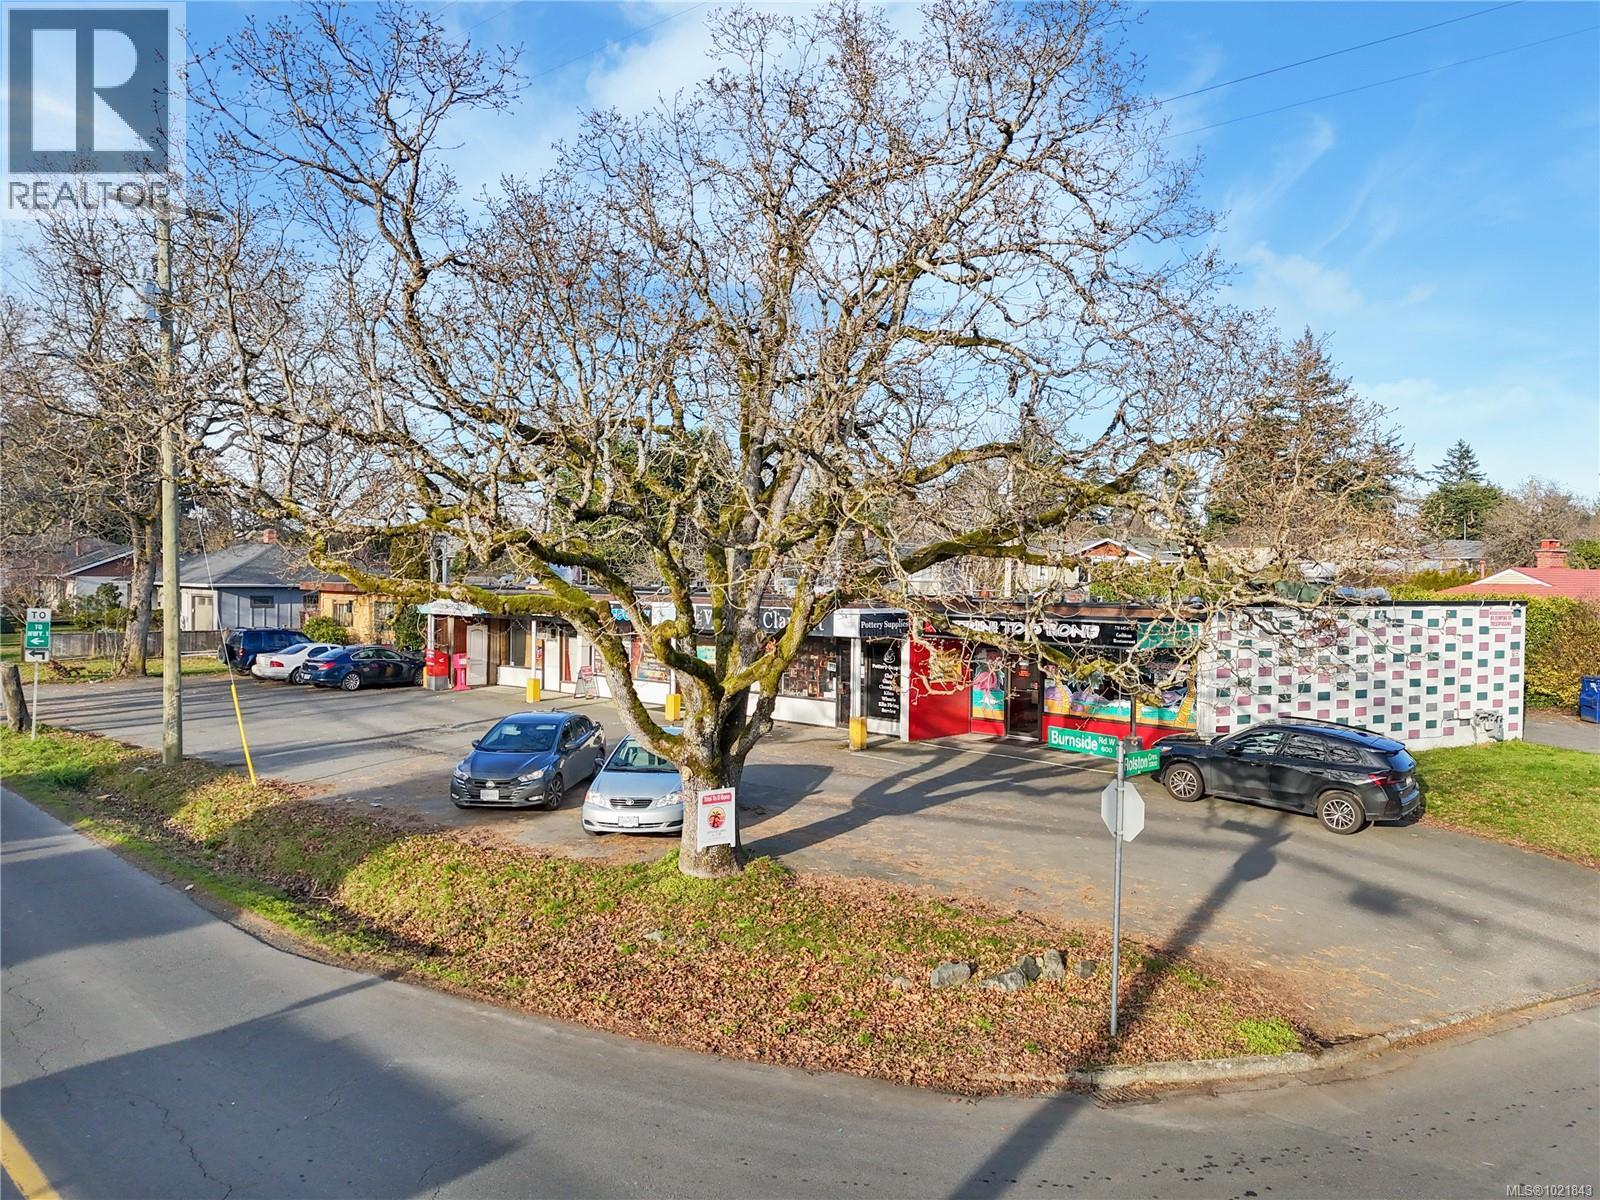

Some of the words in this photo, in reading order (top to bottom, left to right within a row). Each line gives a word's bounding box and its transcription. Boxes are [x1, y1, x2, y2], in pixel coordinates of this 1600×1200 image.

[32, 611, 46, 619] TO
[763, 611, 791, 629] Cla
[861, 621, 883, 630] Pottery
[884, 620, 909, 629] Supplies
[1051, 730, 1098, 751] Burnside
[1099, 737, 1107, 745] Rd
[1124, 755, 1148, 772] Rolston
